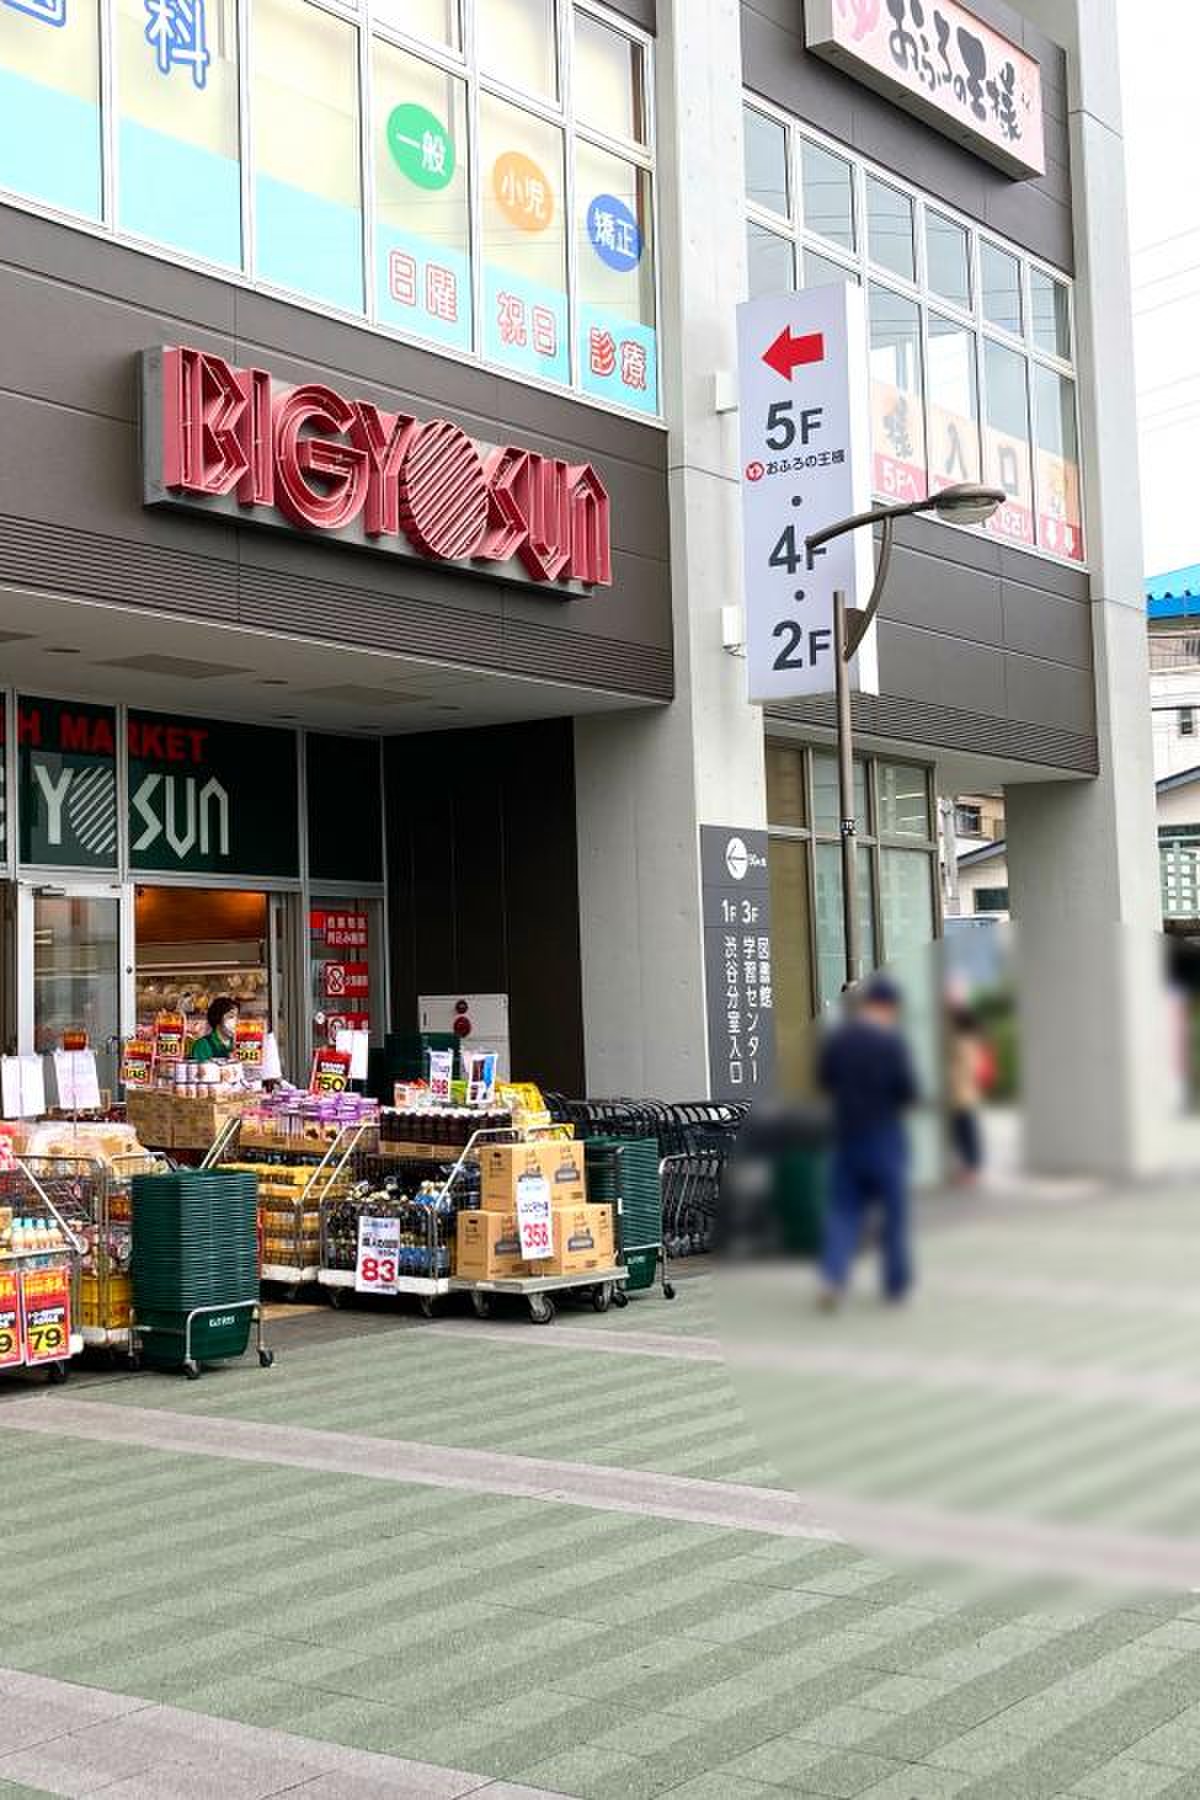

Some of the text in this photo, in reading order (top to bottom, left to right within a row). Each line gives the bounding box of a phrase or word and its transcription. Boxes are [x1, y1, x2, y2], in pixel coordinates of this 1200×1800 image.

[394, 128, 448, 178] 一般
[500, 173, 547, 218] 小児
[594, 206, 638, 258] 矯正
[388, 251, 648, 391] 日曜 祝日 診療
[765, 400, 823, 451] 5F
[766, 448, 846, 475] おふろの王様
[768, 525, 827, 574] 4F
[772, 619, 832, 671] 2F
[59, 712, 208, 763] MARKET
[721, 900, 760, 922] 1F 3F
[362, 1258, 395, 1282] 83
[30, 1327, 61, 1350] 79
